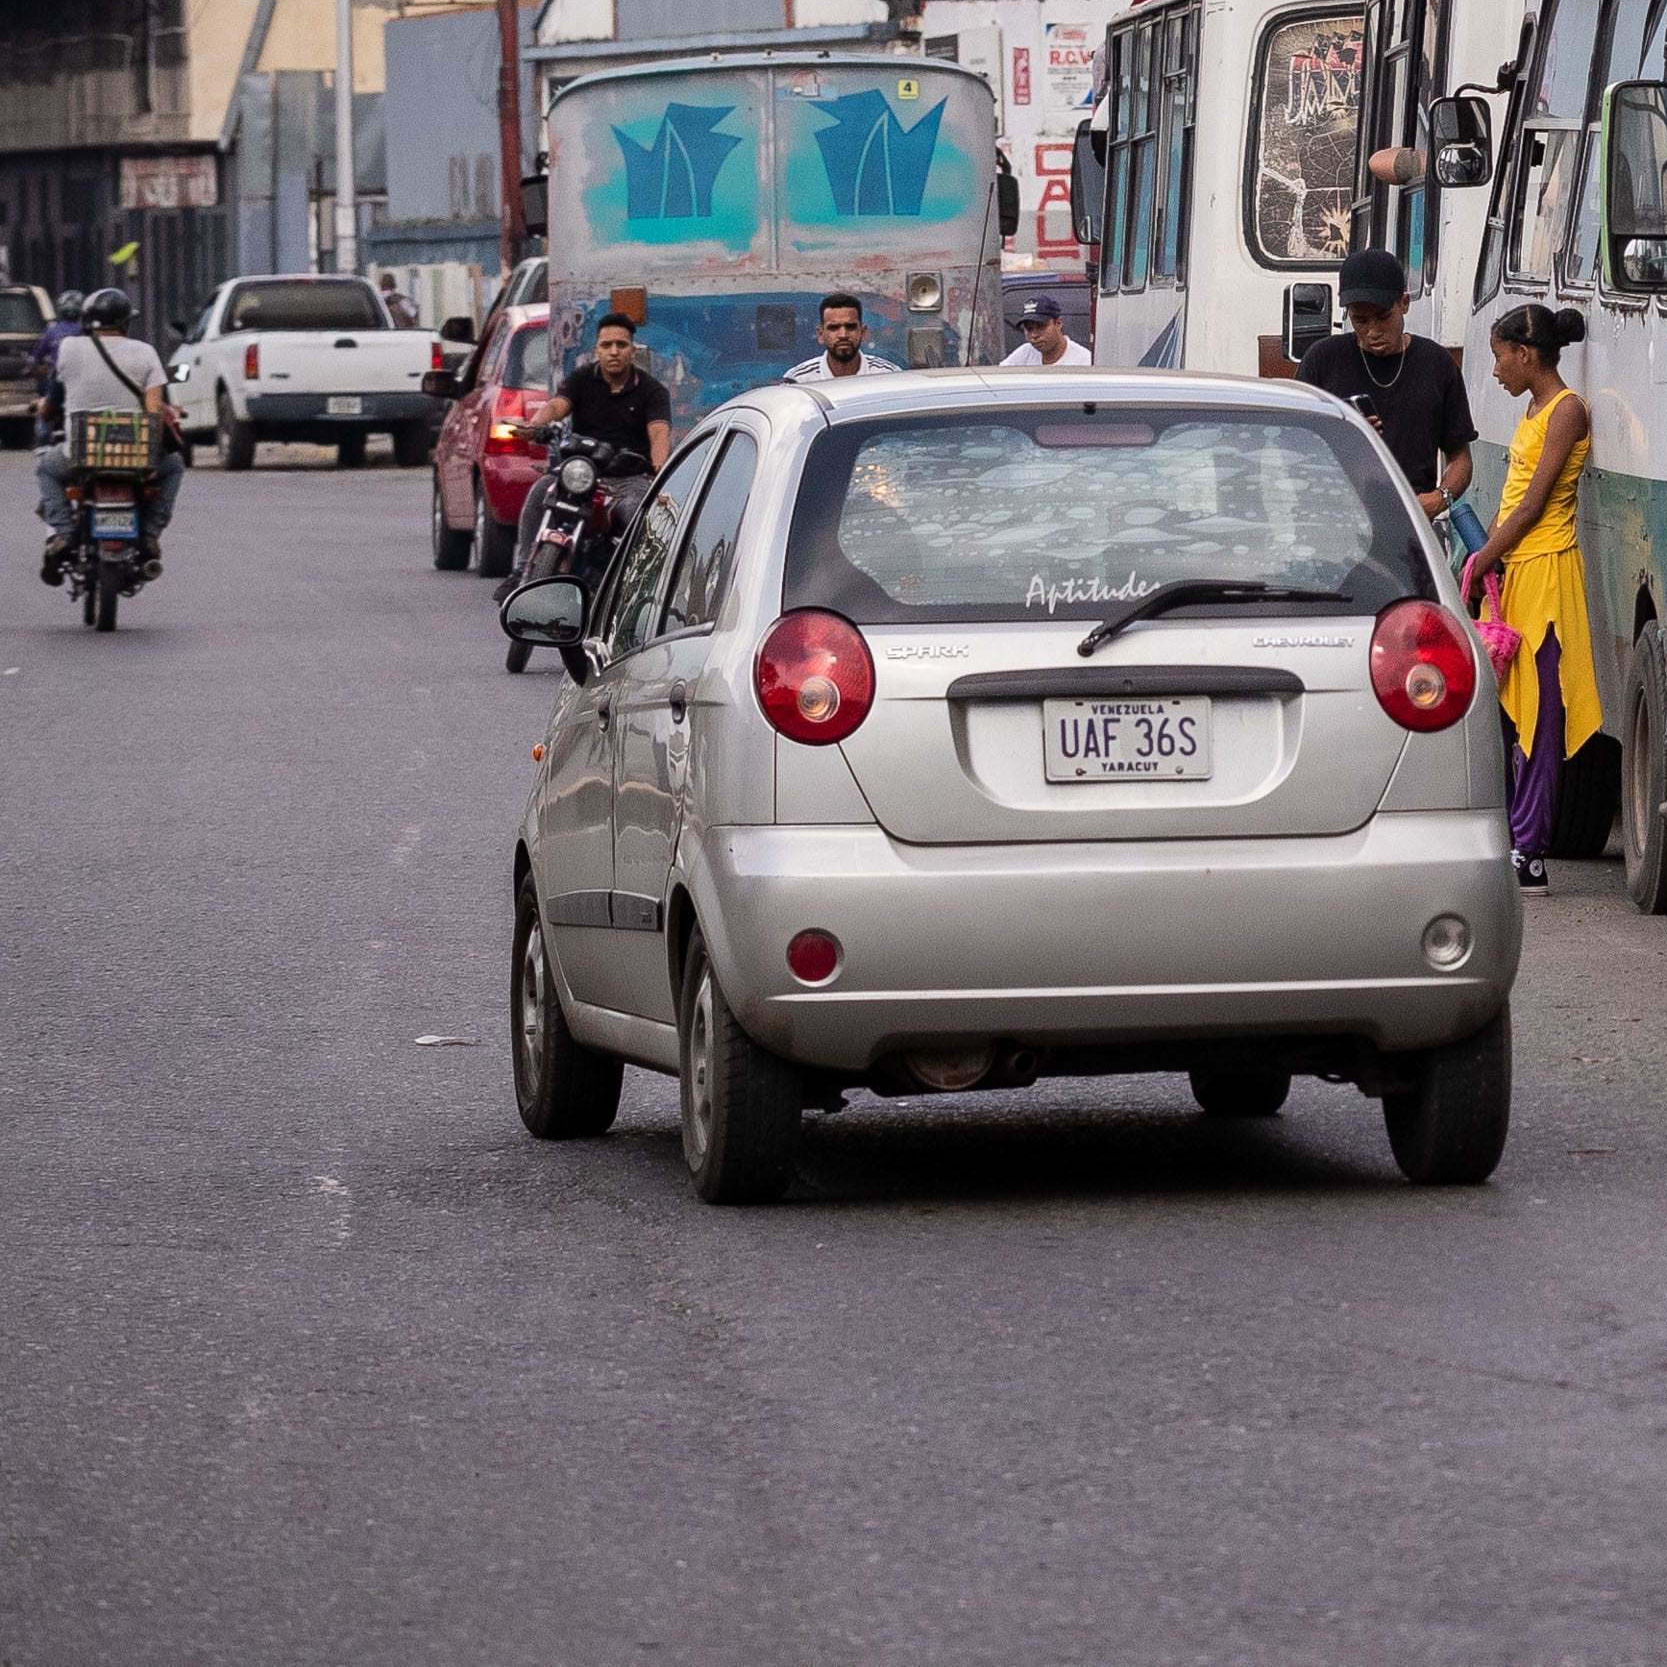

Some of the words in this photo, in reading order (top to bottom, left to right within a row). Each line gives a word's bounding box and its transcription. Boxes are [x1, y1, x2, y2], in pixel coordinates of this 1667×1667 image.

[1252, 636, 1356, 648] CHEVROLET
[886, 645, 969, 660] SPARK
[1091, 704, 1165, 716] VENEZUELA
[1060, 718, 1121, 758] UAF
[1134, 716, 1197, 757] 36S
[1101, 761, 1159, 773] YARACUY
